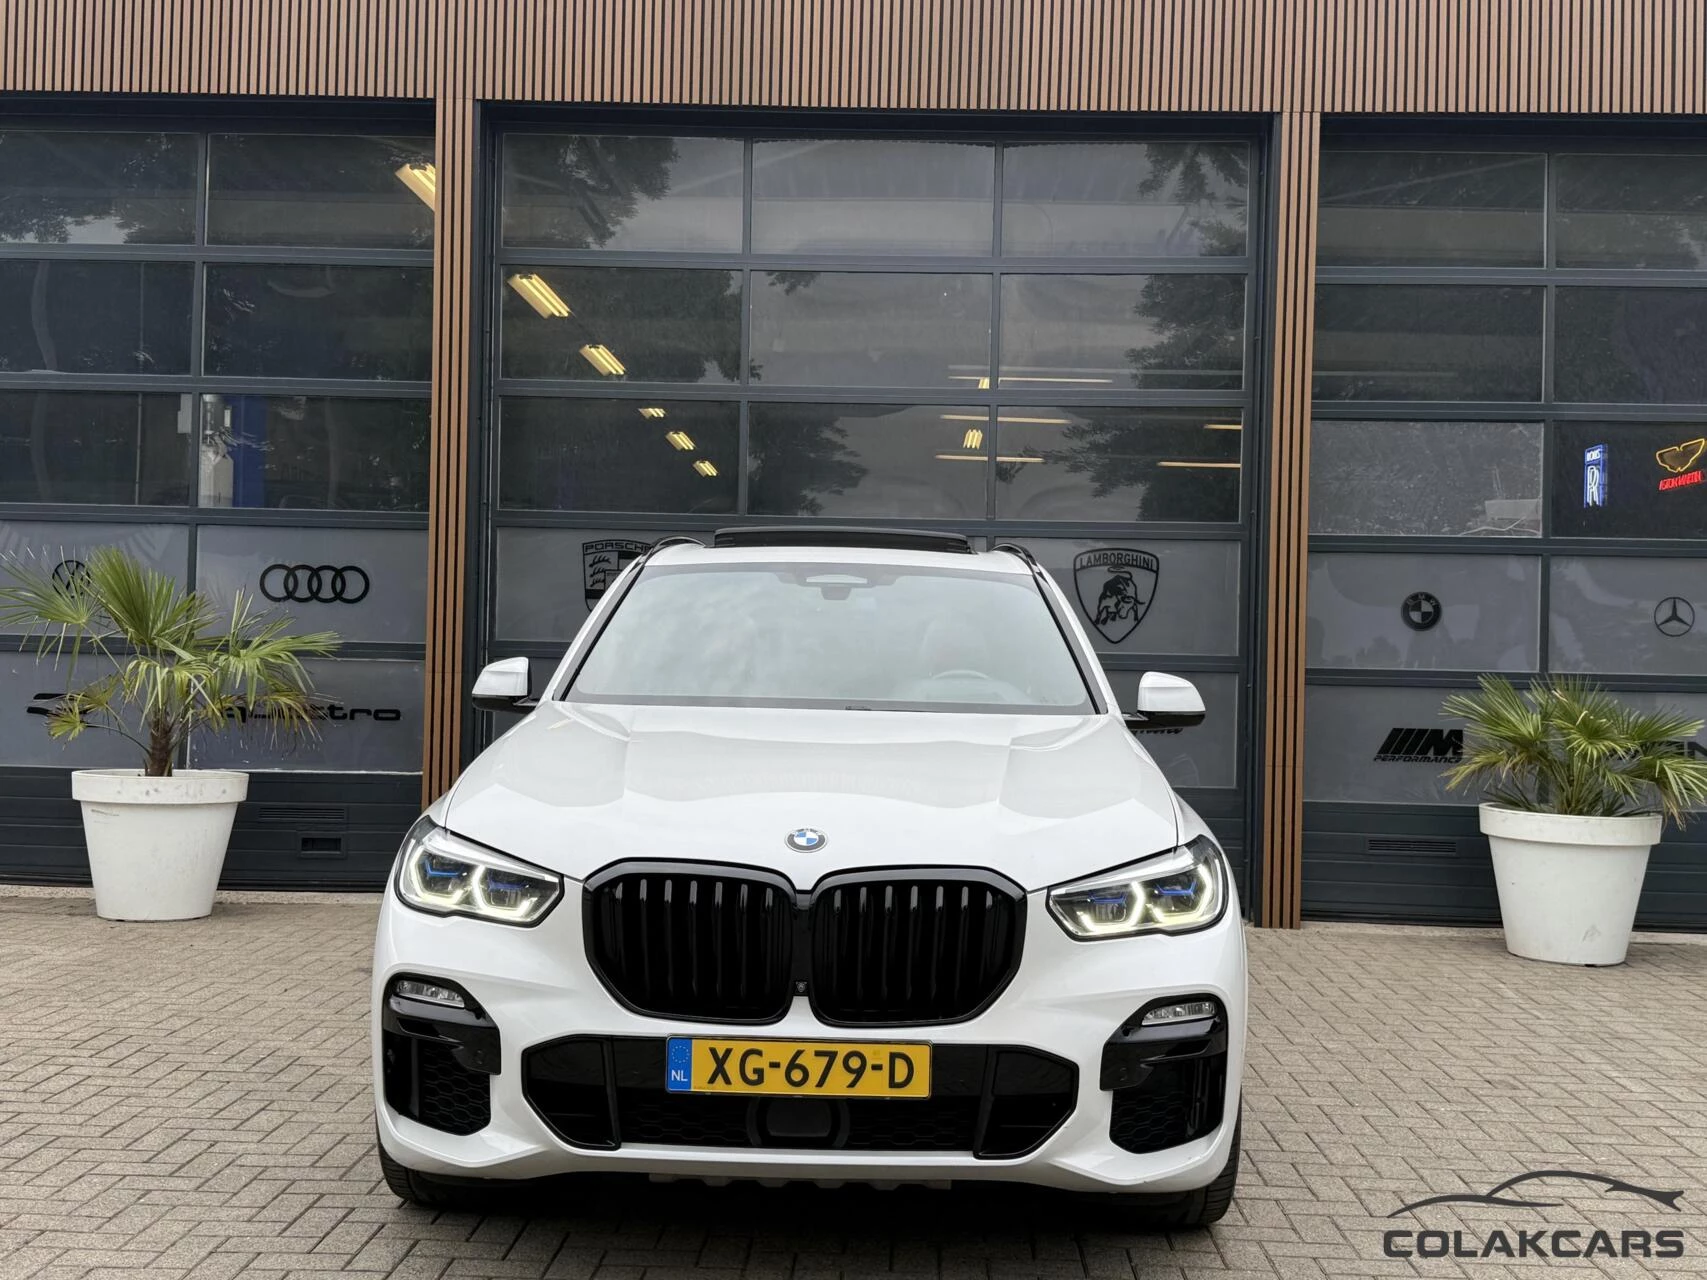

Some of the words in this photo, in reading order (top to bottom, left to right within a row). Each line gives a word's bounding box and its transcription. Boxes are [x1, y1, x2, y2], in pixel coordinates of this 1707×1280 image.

[1079, 552, 1154, 569] LAMBORGHINI
[671, 1069, 689, 1082] NL
[707, 1046, 915, 1089] XG-679-D
